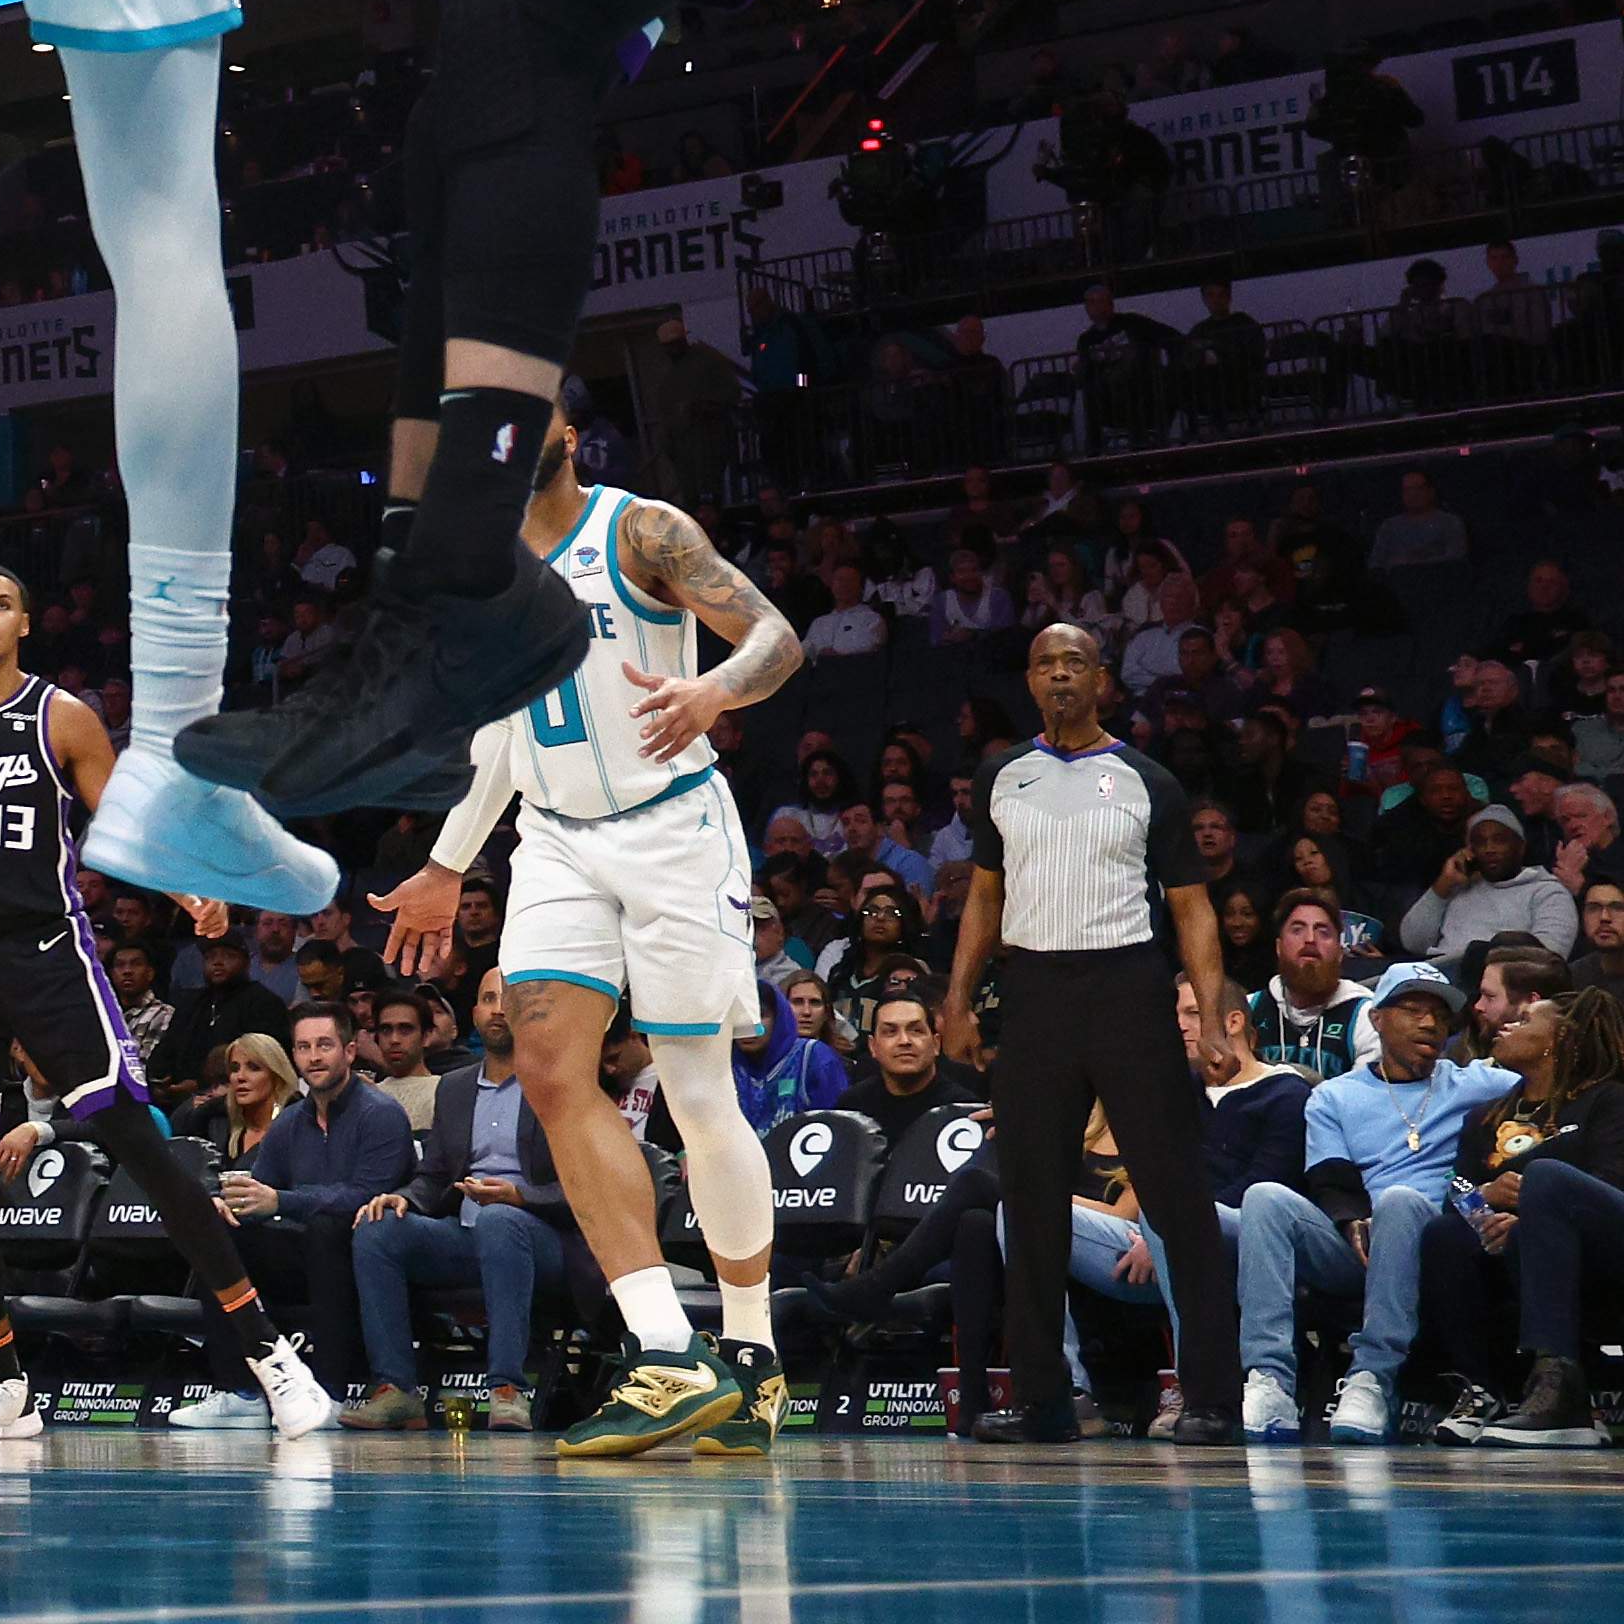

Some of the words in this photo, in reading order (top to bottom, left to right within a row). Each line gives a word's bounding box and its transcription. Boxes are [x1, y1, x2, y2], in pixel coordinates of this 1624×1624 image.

[1476, 59, 1555, 104] 114
[61, 1382, 116, 1397] UTILITY
[868, 1382, 938, 1398] UTILITY
[73, 1398, 142, 1410] INNOVATION
[151, 1396, 172, 1414] 26
[52, 1410, 90, 1423] GROUP
[862, 1414, 909, 1427] GROUP
